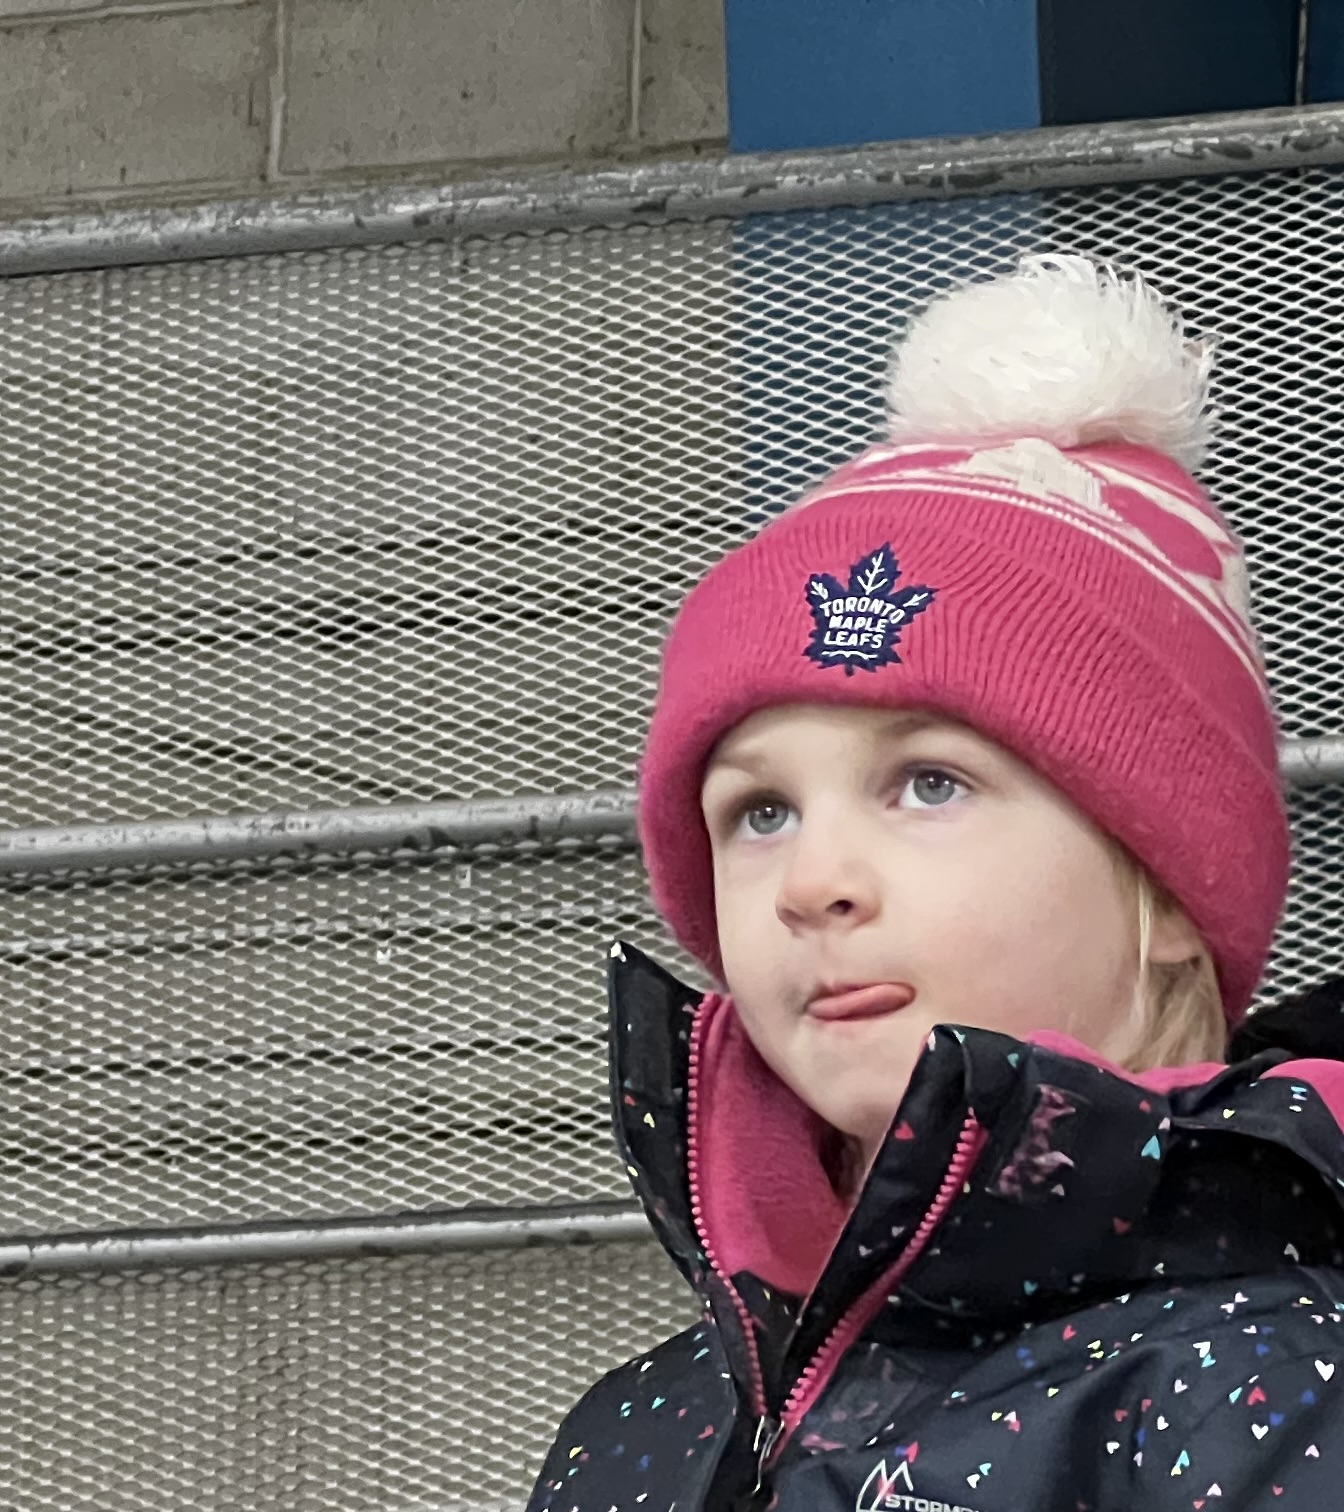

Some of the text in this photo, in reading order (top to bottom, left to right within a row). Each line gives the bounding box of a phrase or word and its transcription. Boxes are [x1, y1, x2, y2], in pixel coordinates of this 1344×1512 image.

[819, 596, 906, 624] TORONTO
[828, 615, 888, 633] MAPLE
[823, 631, 884, 648] LEAFS
